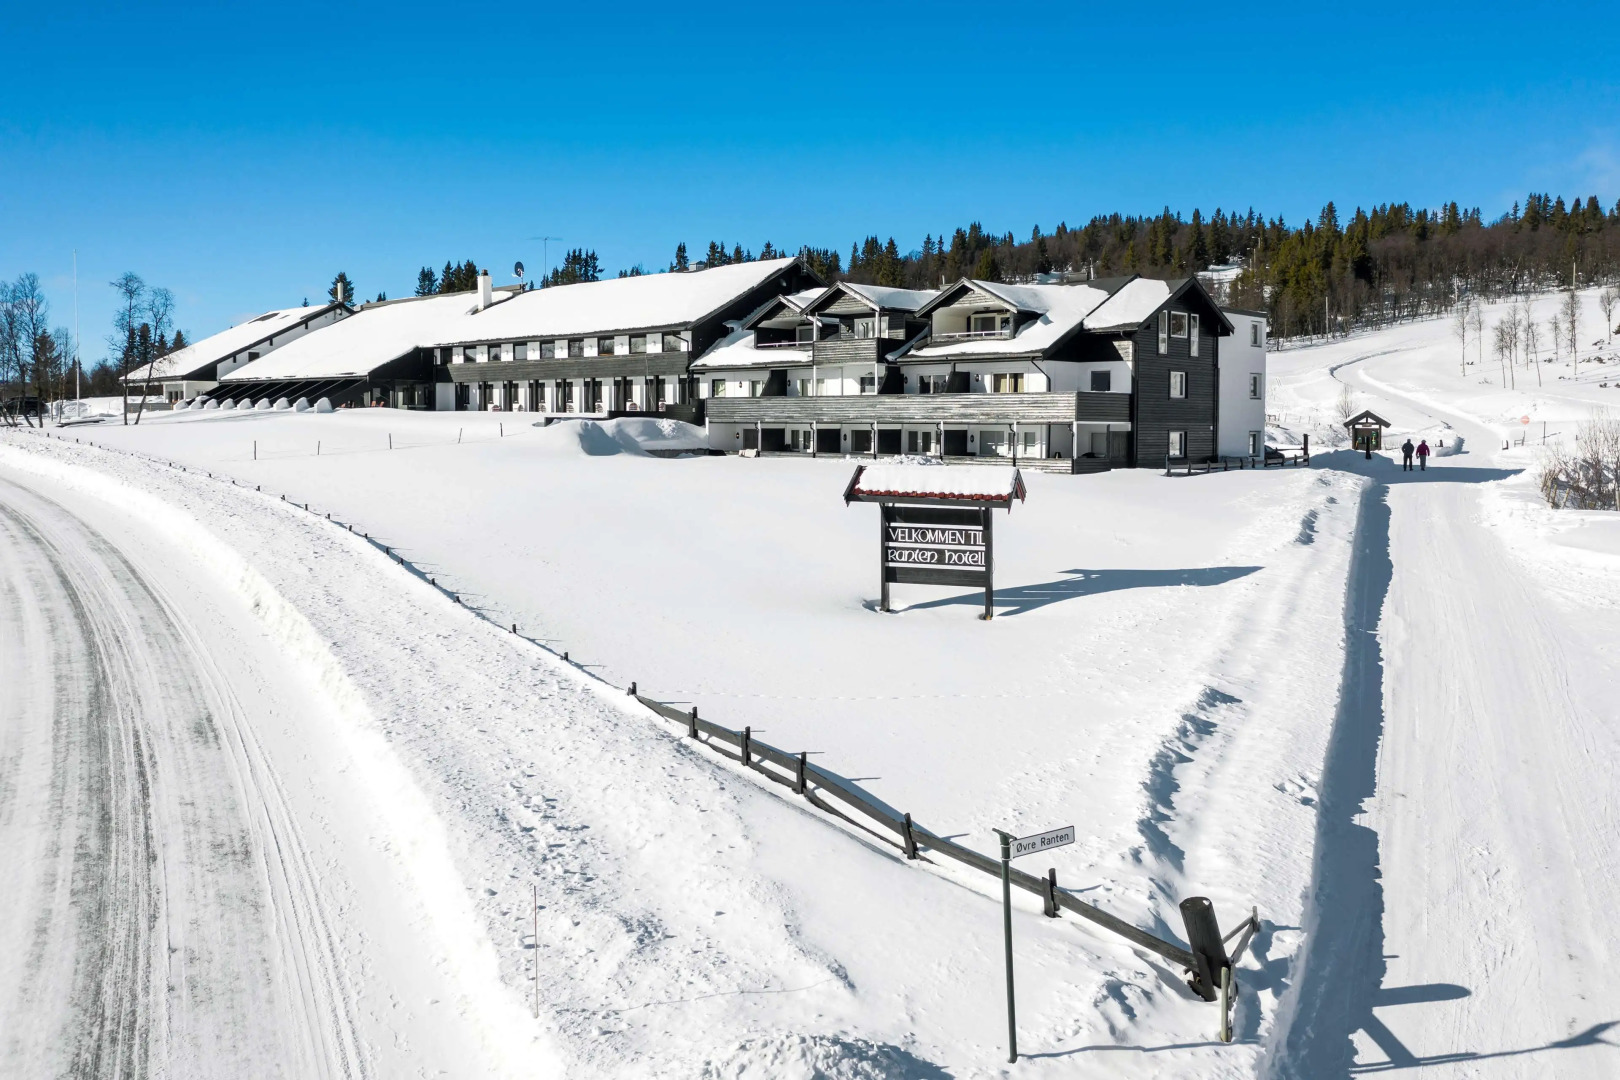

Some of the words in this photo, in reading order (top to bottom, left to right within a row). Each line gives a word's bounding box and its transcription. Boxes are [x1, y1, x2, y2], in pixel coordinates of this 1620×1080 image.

[889, 528, 965, 544] VELKOMMEN
[967, 530, 986, 545] TIL
[1016, 841, 1036, 853] Øvre
[1040, 833, 1069, 847] Ranten
